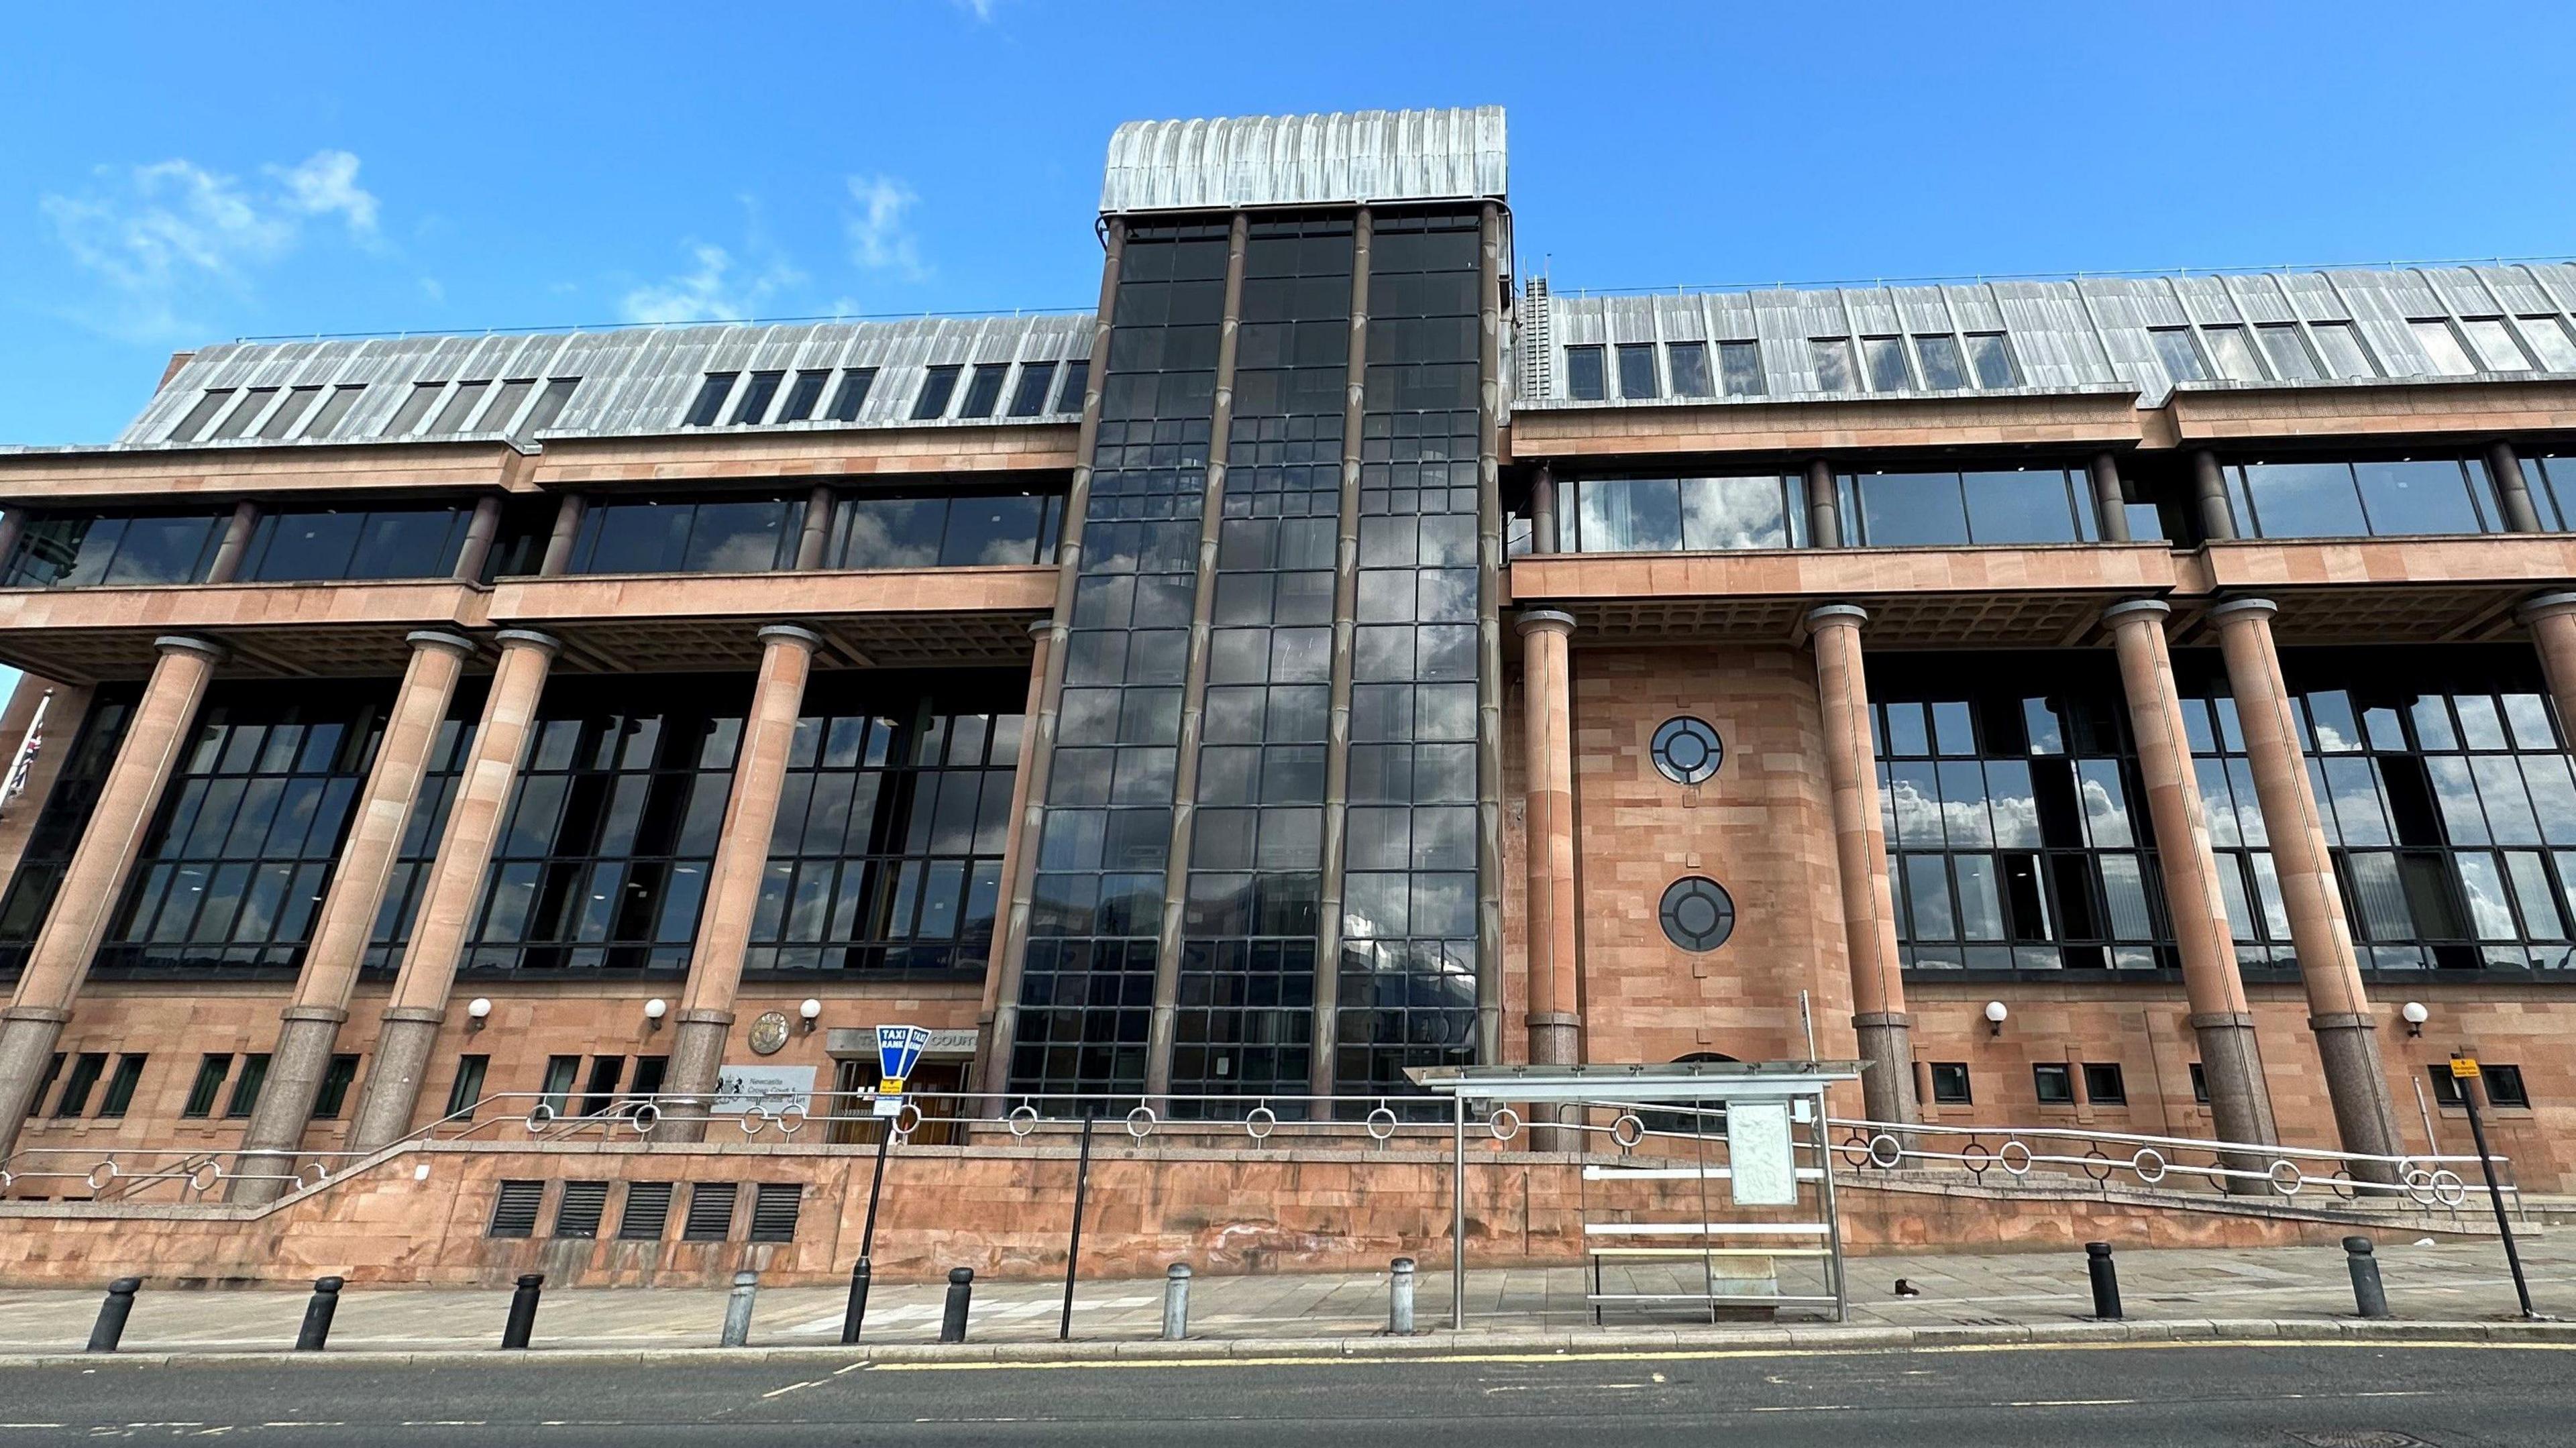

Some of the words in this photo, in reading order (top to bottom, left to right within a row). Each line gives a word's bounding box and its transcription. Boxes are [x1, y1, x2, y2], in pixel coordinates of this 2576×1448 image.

[882, 1029, 906, 1040] TAXI
[881, 1040, 904, 1048] RANK
[932, 1036, 977, 1046] COURT
